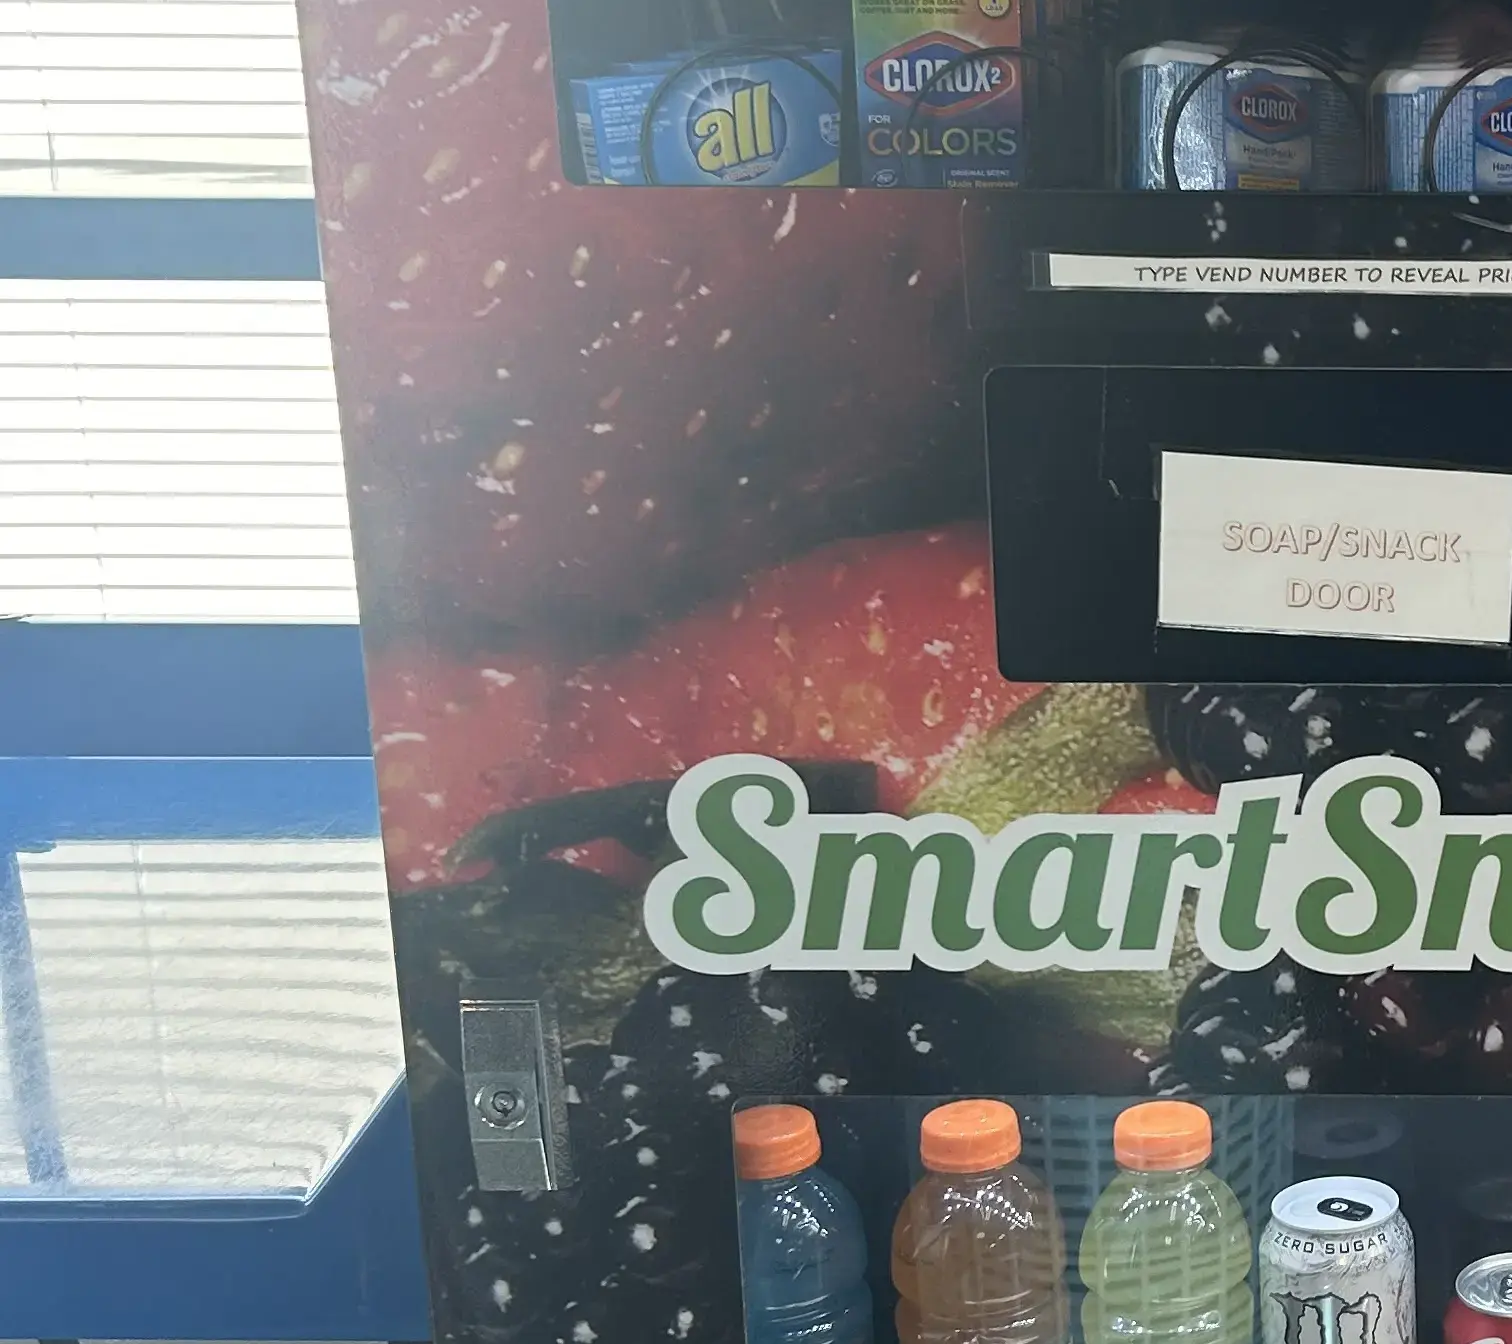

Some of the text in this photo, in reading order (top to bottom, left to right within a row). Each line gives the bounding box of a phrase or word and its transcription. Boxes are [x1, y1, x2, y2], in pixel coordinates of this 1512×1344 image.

[868, 114, 891, 124] FOR
[1241, 95, 1298, 122] CLOROX
[693, 81, 775, 171] all
[867, 127, 1017, 156] COLORS
[1135, 266, 1187, 283] TYPE
[1194, 266, 1252, 283] VEND
[1259, 267, 1348, 285] NUMBER
[1353, 267, 1383, 285] TO
[1389, 266, 1470, 285] REVEAL
[1221, 520, 1463, 564] SOAP/SNACK
[1285, 577, 1396, 613] DOOR
[1273, 1231, 1389, 1255] ZERO SUGAR
